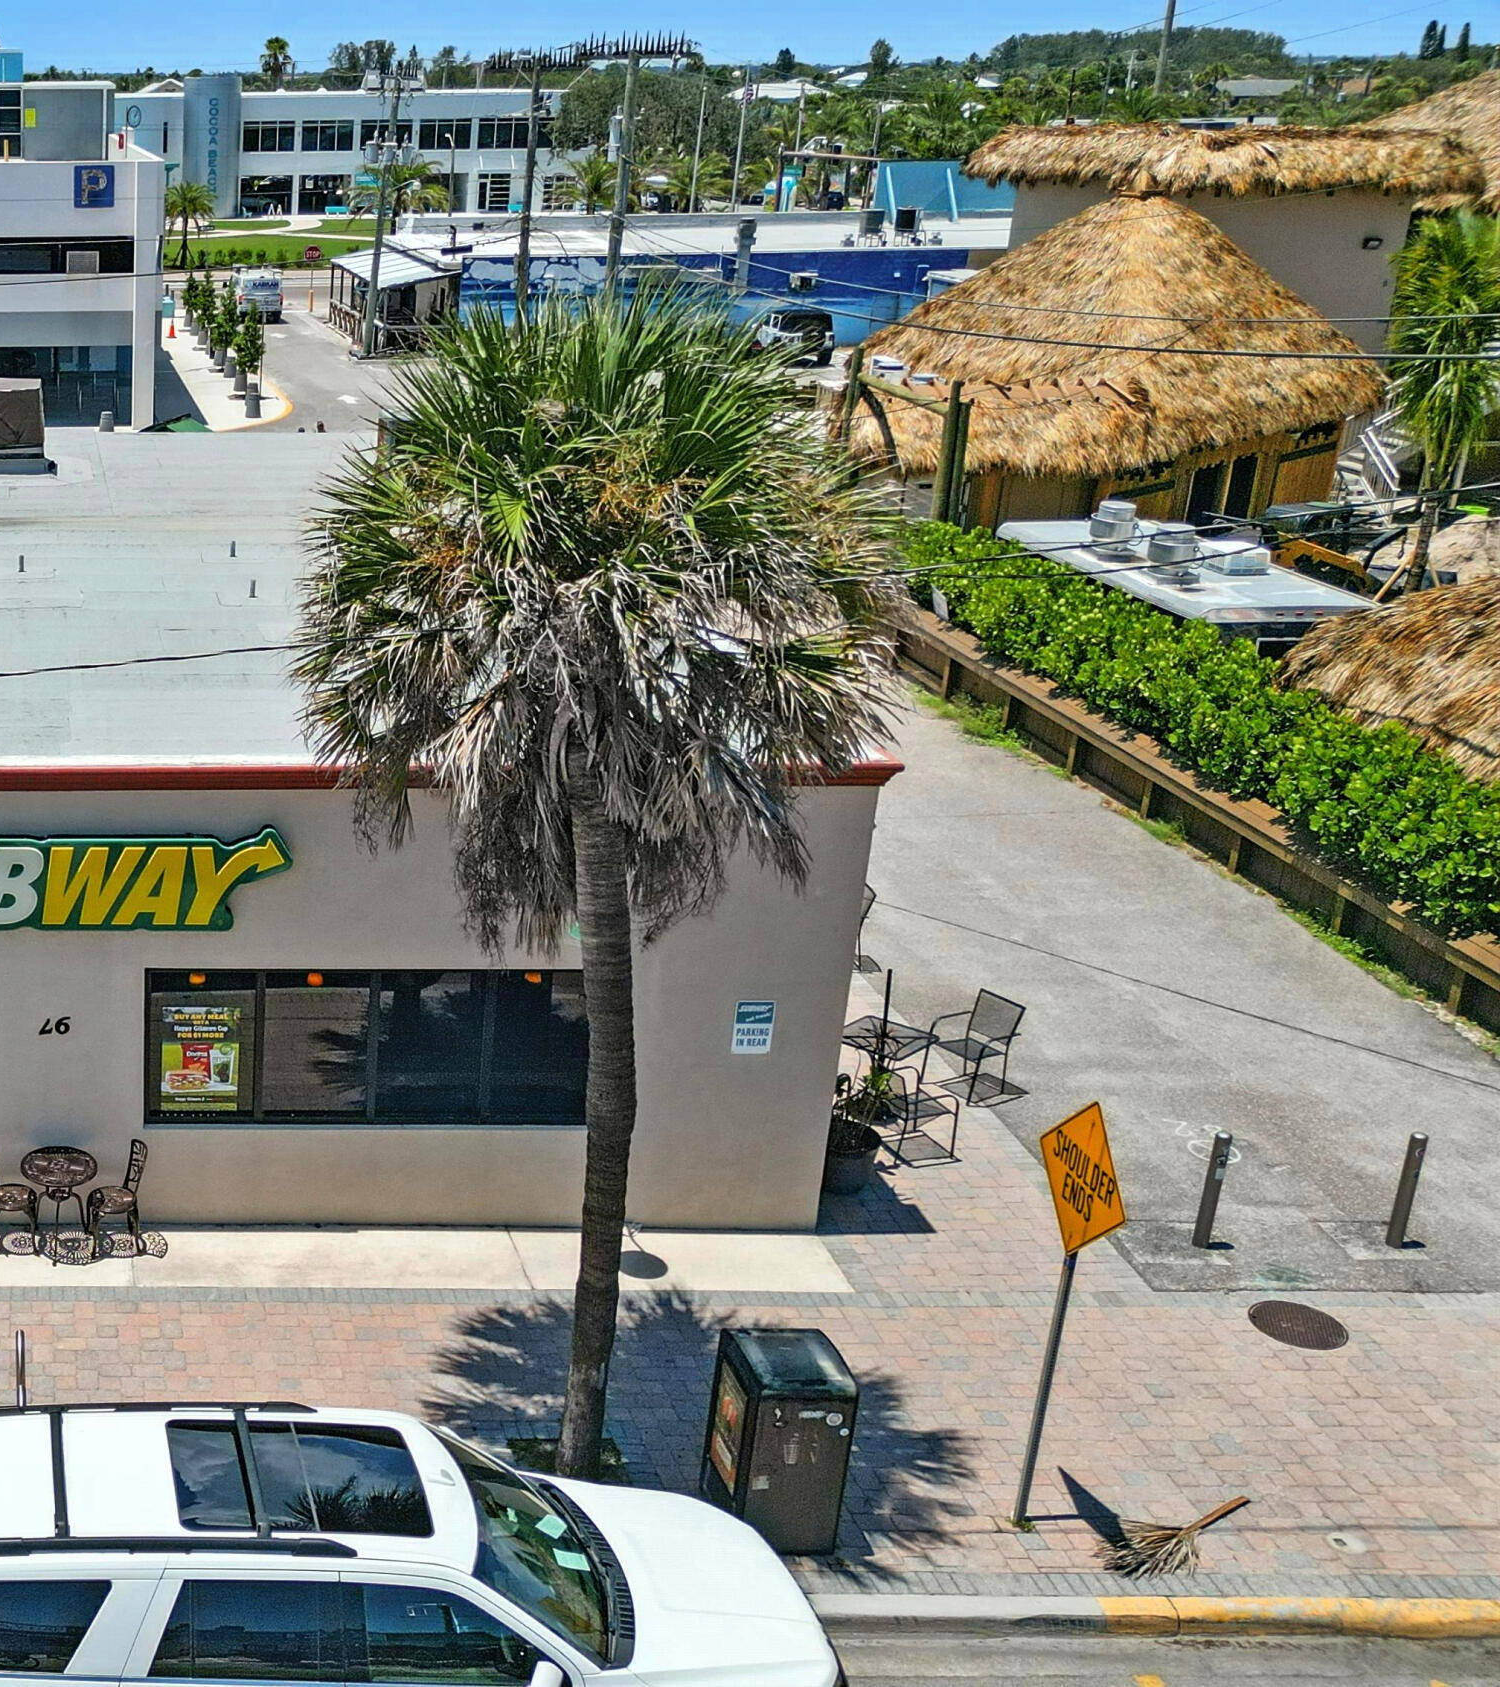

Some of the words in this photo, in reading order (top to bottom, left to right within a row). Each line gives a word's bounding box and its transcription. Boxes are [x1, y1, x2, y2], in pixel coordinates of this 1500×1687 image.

[208, 98, 219, 145] COCOA
[81, 169, 107, 204] P
[736, 1027, 770, 1037] PARKING
[736, 1038, 745, 1047] IN
[746, 1038, 768, 1047] REAR
[1053, 1129, 1116, 1208] SHOULDER
[1061, 1171, 1094, 1223] ENDS
